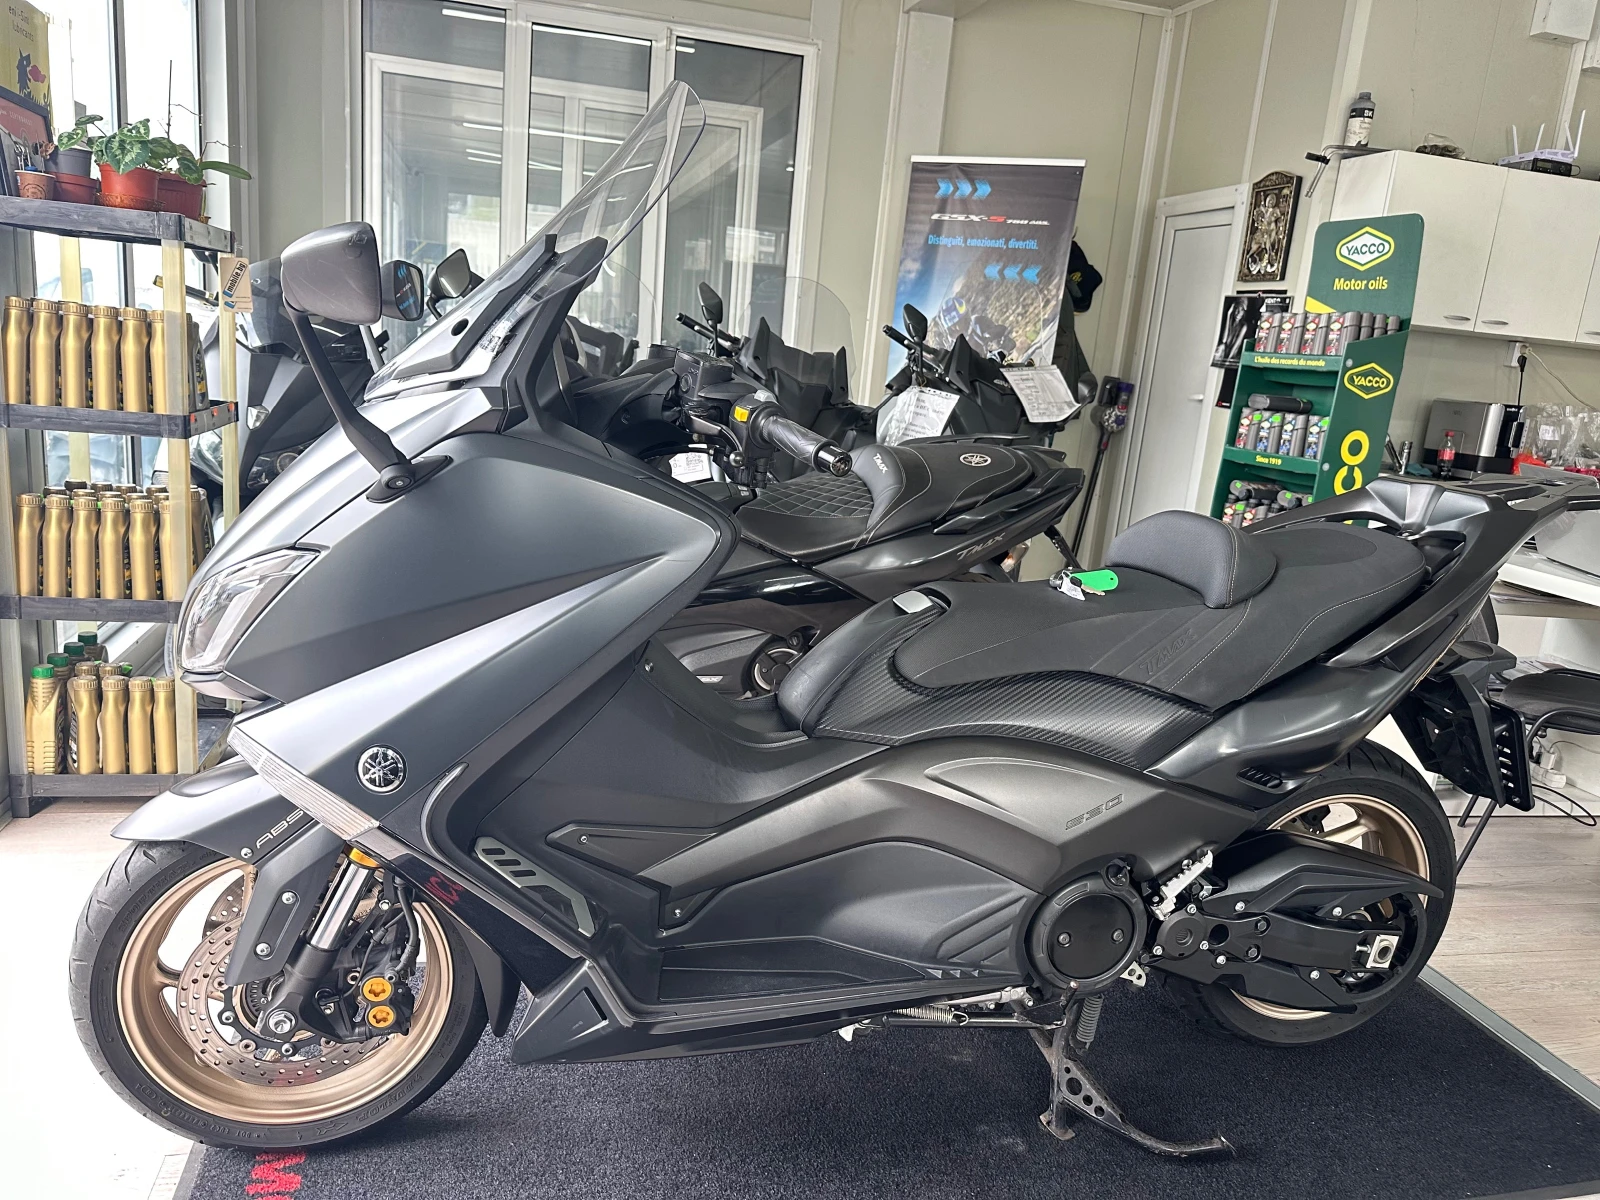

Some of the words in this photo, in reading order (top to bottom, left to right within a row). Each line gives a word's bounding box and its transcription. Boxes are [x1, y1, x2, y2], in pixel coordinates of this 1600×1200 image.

[928, 234, 965, 248] Distinguiti,
[966, 238, 1006, 250] emozionati,
[1008, 238, 1039, 250] divertiti.
[1345, 242, 1386, 256] YACCO
[227, 262, 246, 293] mobile.bg
[1333, 277, 1367, 291] Motor
[1368, 276, 1388, 290] oils
[1280, 357, 1299, 366] records
[1299, 358, 1307, 366] du
[1306, 359, 1326, 367] monde
[1353, 375, 1387, 389] YACCO
[1255, 454, 1269, 464] Since
[1269, 457, 1282, 466] 1919
[1065, 793, 1123, 831] 530
[256, 808, 304, 850] ABS
